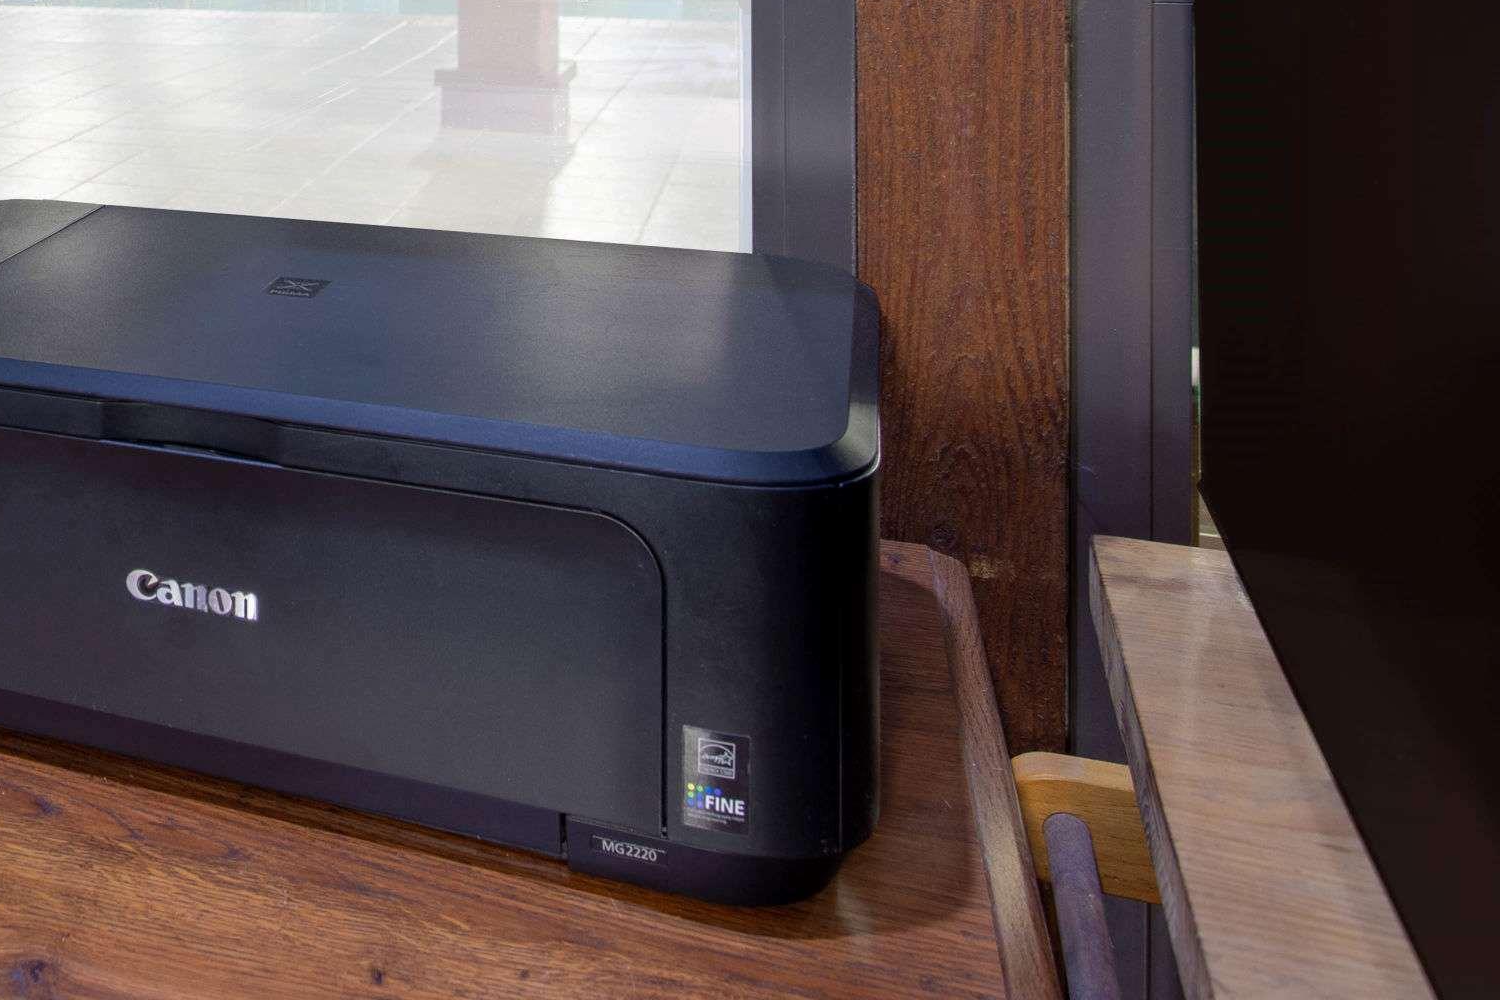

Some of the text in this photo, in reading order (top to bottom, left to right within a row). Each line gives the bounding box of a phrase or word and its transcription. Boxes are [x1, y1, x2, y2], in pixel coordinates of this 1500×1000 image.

[126, 569, 258, 621] Canon
[705, 795, 745, 816] FINE
[601, 839, 658, 862] MG2220
